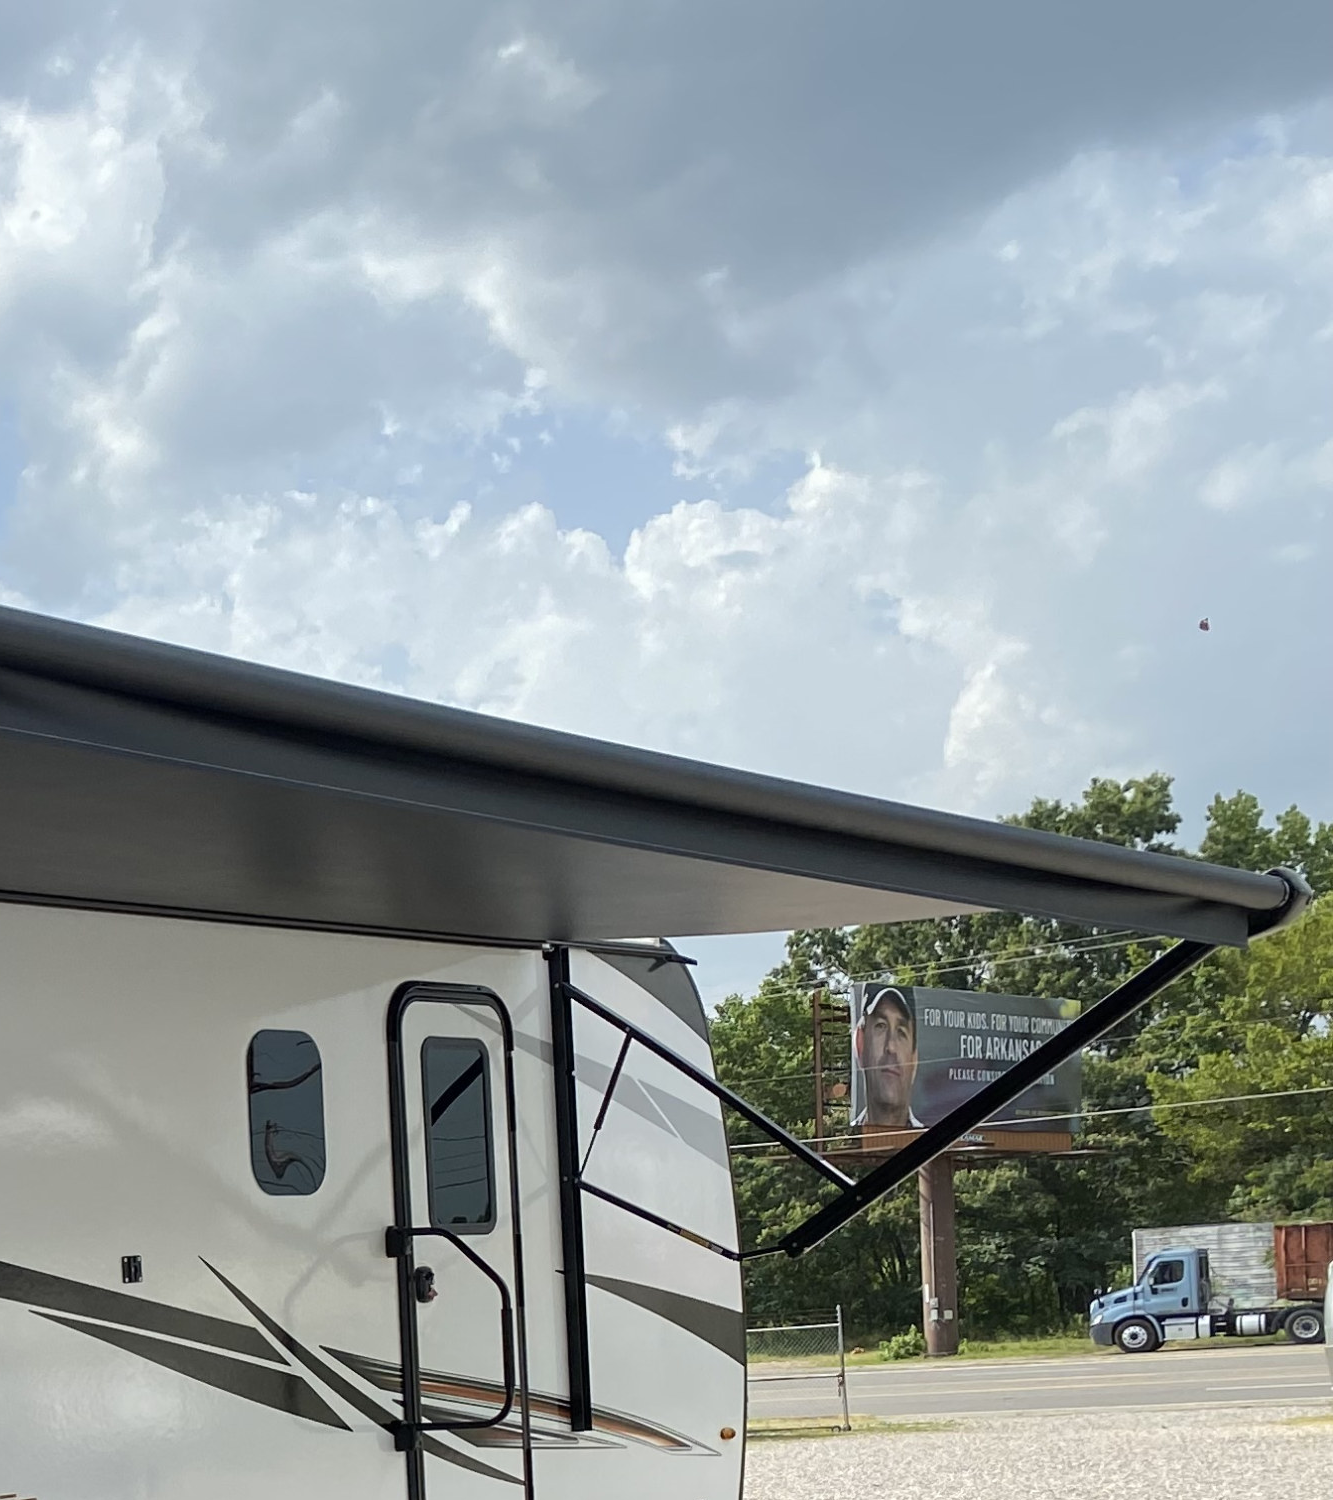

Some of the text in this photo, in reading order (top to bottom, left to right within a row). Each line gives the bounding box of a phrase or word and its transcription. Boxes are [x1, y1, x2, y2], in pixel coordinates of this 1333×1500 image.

[924, 1008, 941, 1027] FOR
[943, 1009, 965, 1029] YOUR
[967, 1011, 989, 1030] KIDS.
[991, 1013, 1007, 1031] FOR
[1008, 1015, 1029, 1033] YOUR
[960, 1034, 982, 1059] FOR
[948, 1068, 975, 1080] PLEASE
